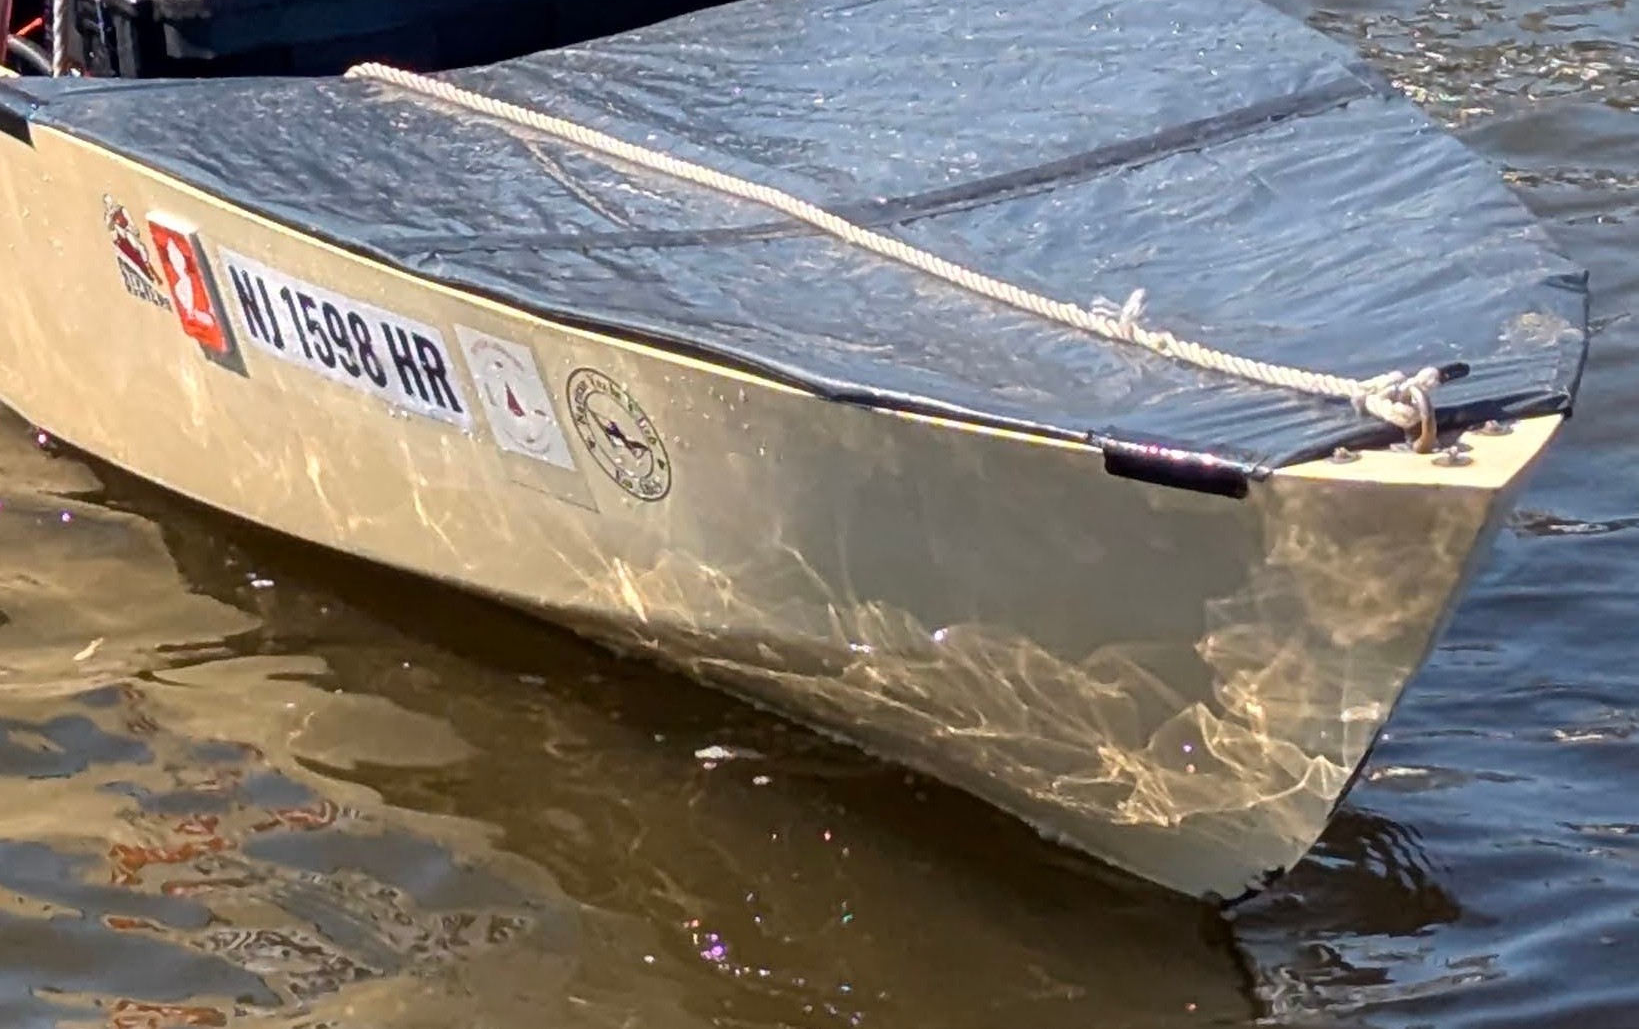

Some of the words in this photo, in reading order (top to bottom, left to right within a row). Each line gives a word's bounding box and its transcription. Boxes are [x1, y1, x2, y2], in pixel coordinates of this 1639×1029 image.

[228, 264, 286, 352] NJ
[279, 285, 388, 388] 1598
[380, 321, 464, 414] HR
